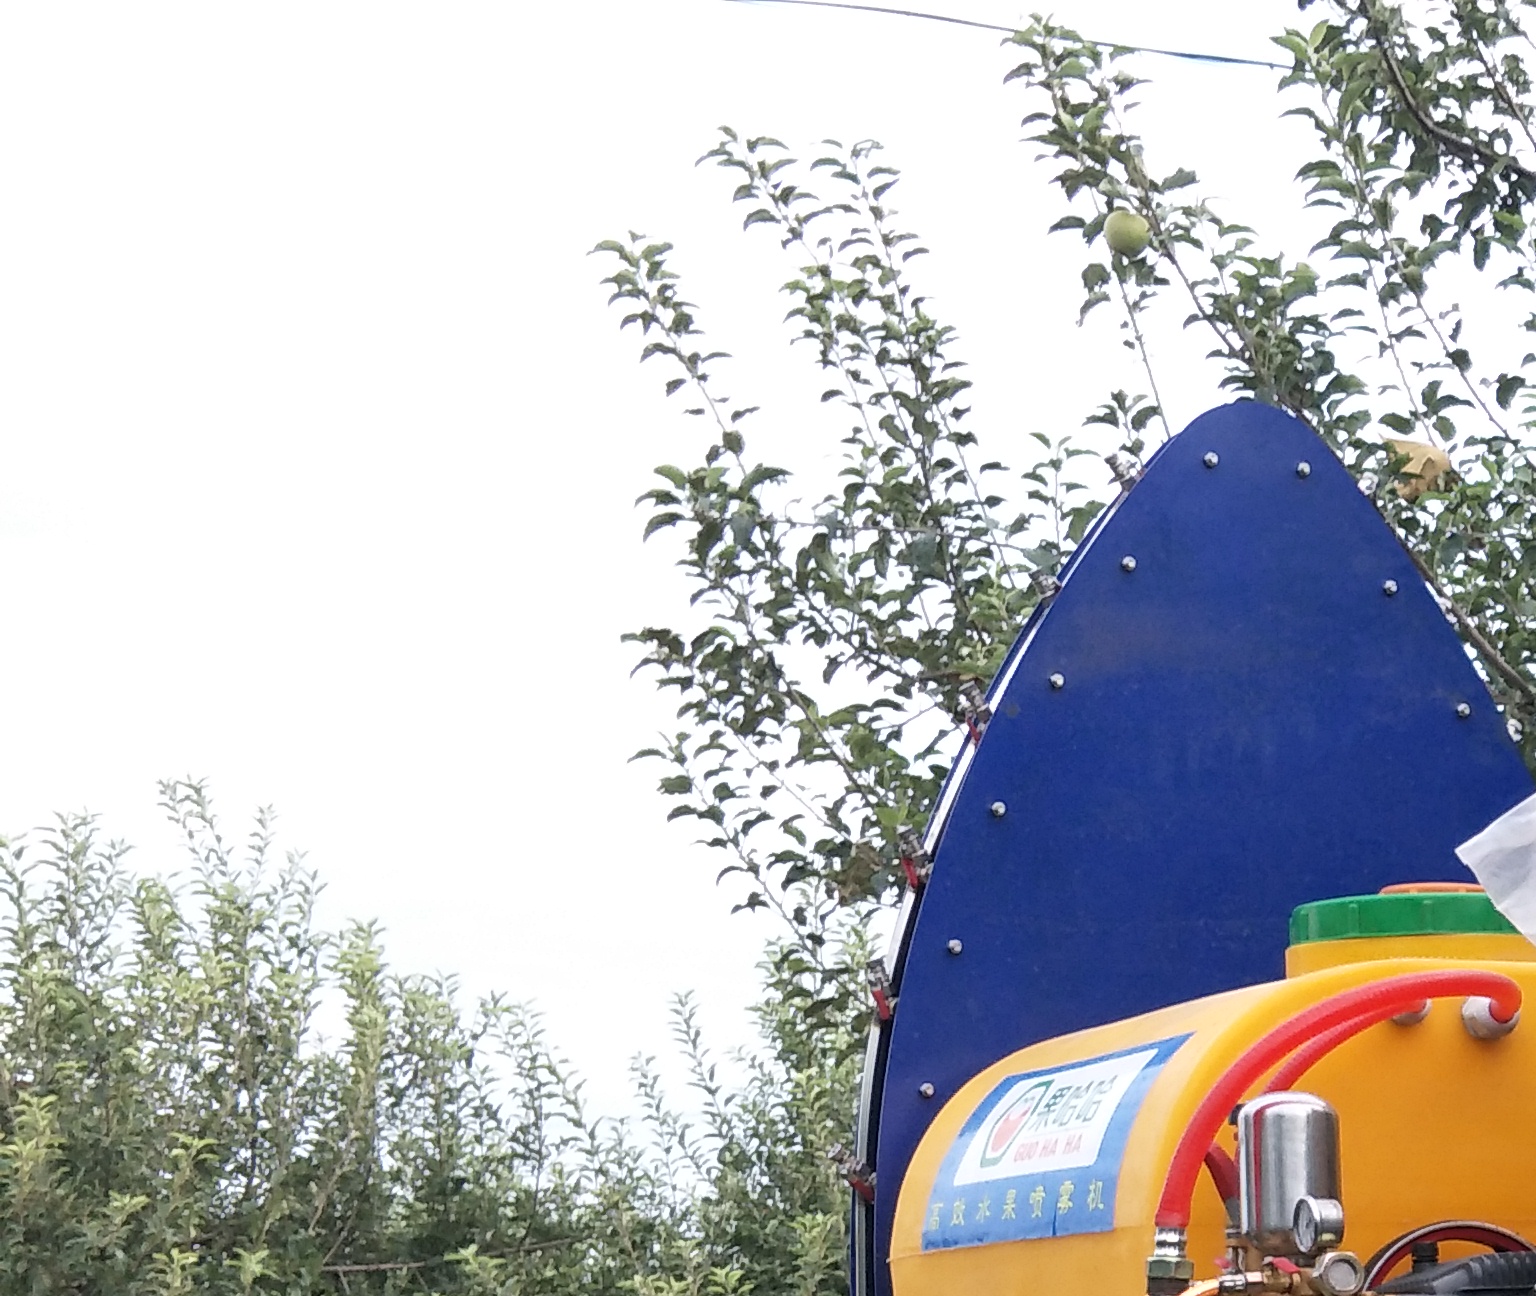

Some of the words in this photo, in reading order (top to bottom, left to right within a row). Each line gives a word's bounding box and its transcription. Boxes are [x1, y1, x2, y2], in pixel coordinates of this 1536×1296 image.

[1028, 1075, 1118, 1132] 果哈哈
[1014, 1141, 1039, 1162] GUO
[1039, 1138, 1059, 1158] HA
[1062, 1133, 1083, 1154] HA
